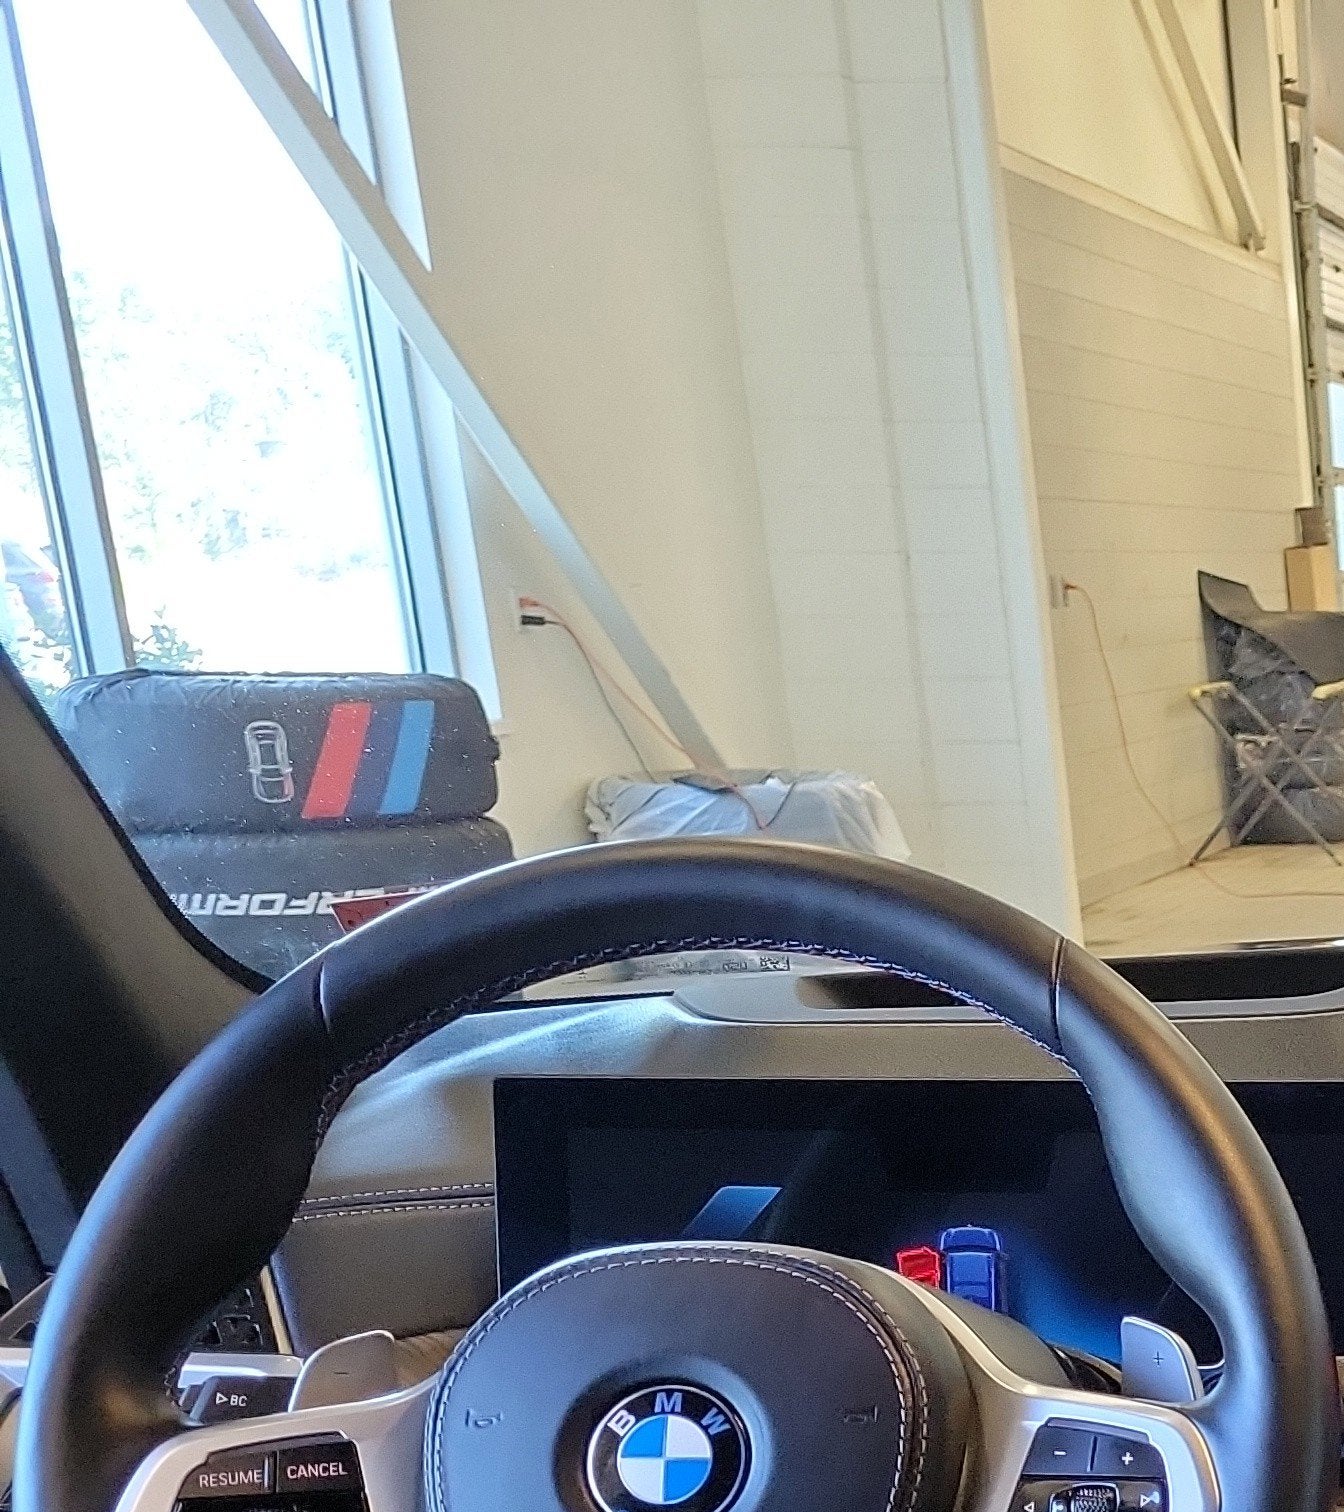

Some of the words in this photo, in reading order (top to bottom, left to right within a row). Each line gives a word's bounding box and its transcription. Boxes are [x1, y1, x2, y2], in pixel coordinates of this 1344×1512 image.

[230, 1395, 247, 1407] BC
[607, 1391, 731, 1437] BMW
[199, 1469, 263, 1488] RESUME
[286, 1462, 348, 1480] CANCEL
